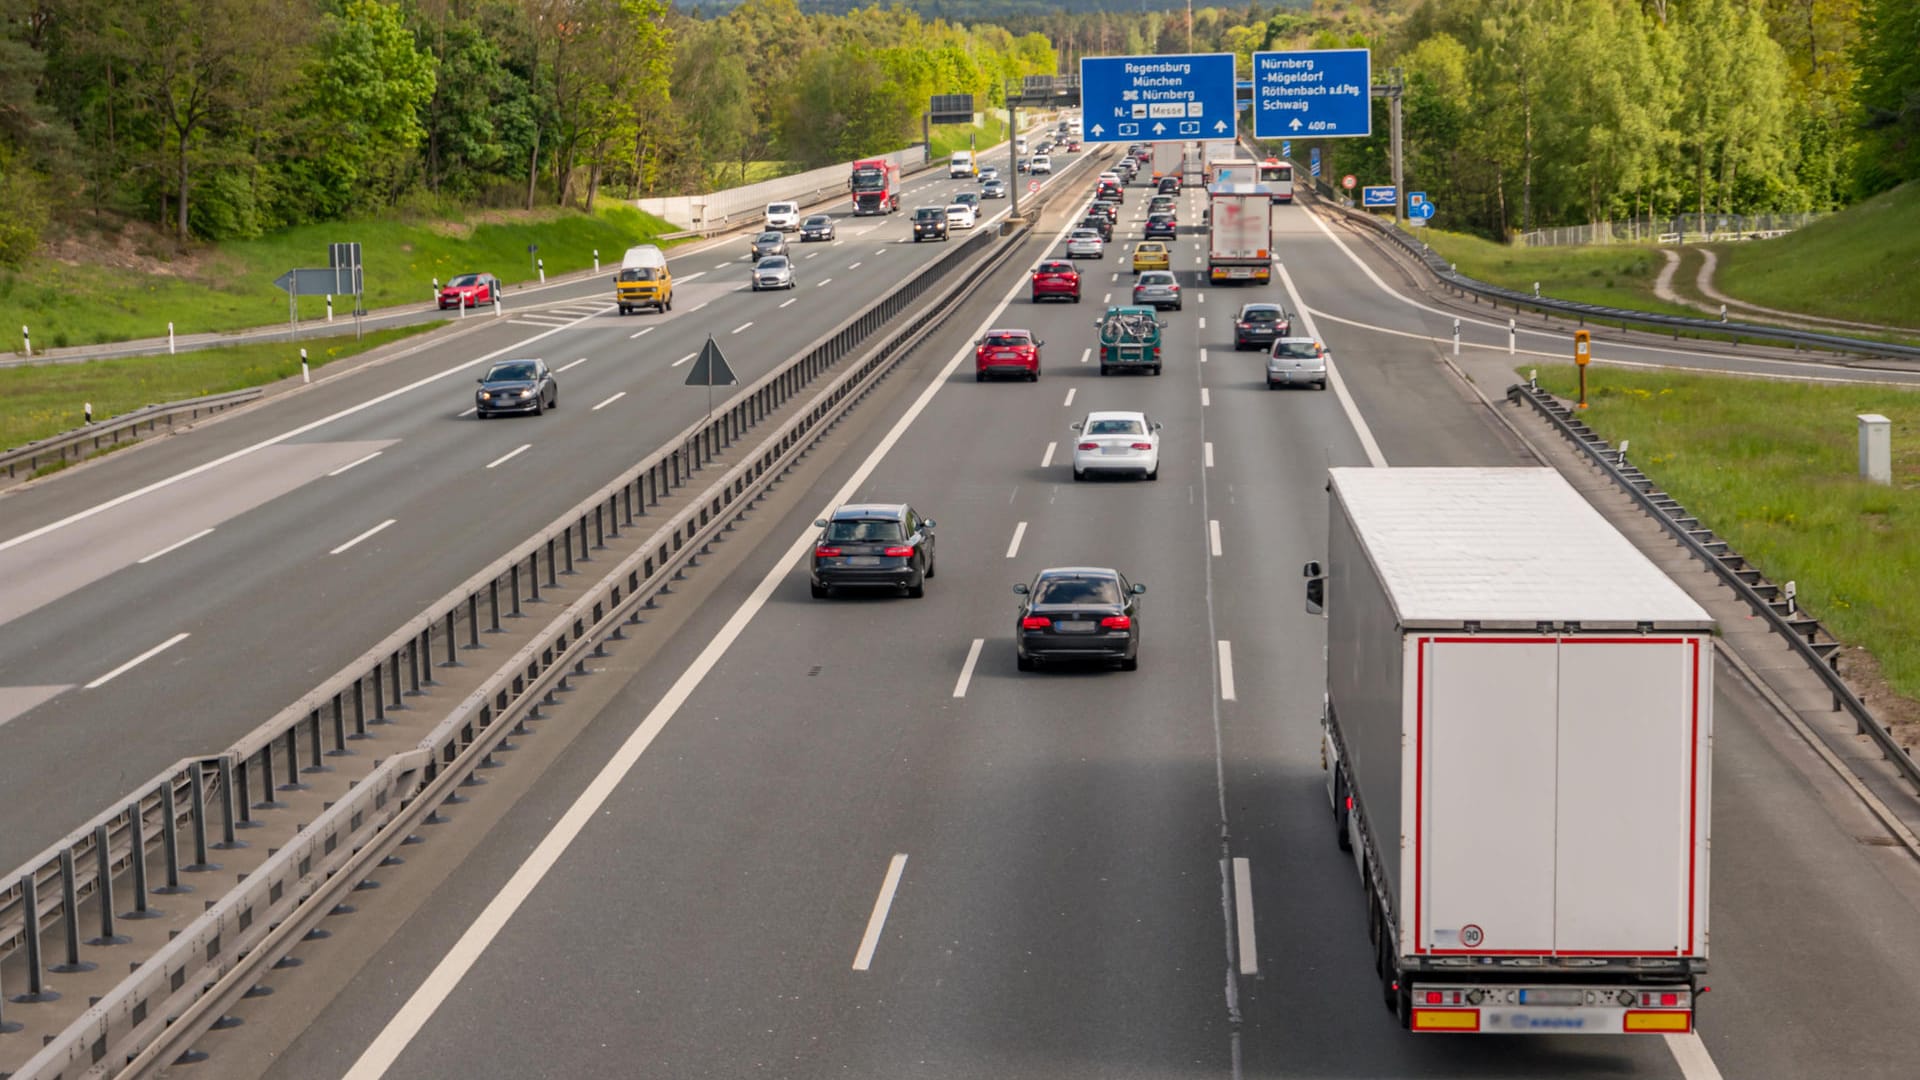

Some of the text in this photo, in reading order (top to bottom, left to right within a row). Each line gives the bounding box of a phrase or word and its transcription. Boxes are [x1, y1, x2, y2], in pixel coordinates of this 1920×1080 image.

[1125, 62, 1191, 75] Regensburg
[1261, 58, 1314, 71] Nürnberg
[1133, 76, 1182, 87] München
[1262, 71, 1324, 85] -Mögeldorf
[1143, 89, 1195, 101] Nürnberg
[1262, 85, 1326, 97] Röthenbach
[1152, 105, 1182, 115] Messe
[1263, 99, 1309, 112] Schwaig
[1308, 121, 1336, 130] 400 m
[1465, 930, 1479, 941] 90
